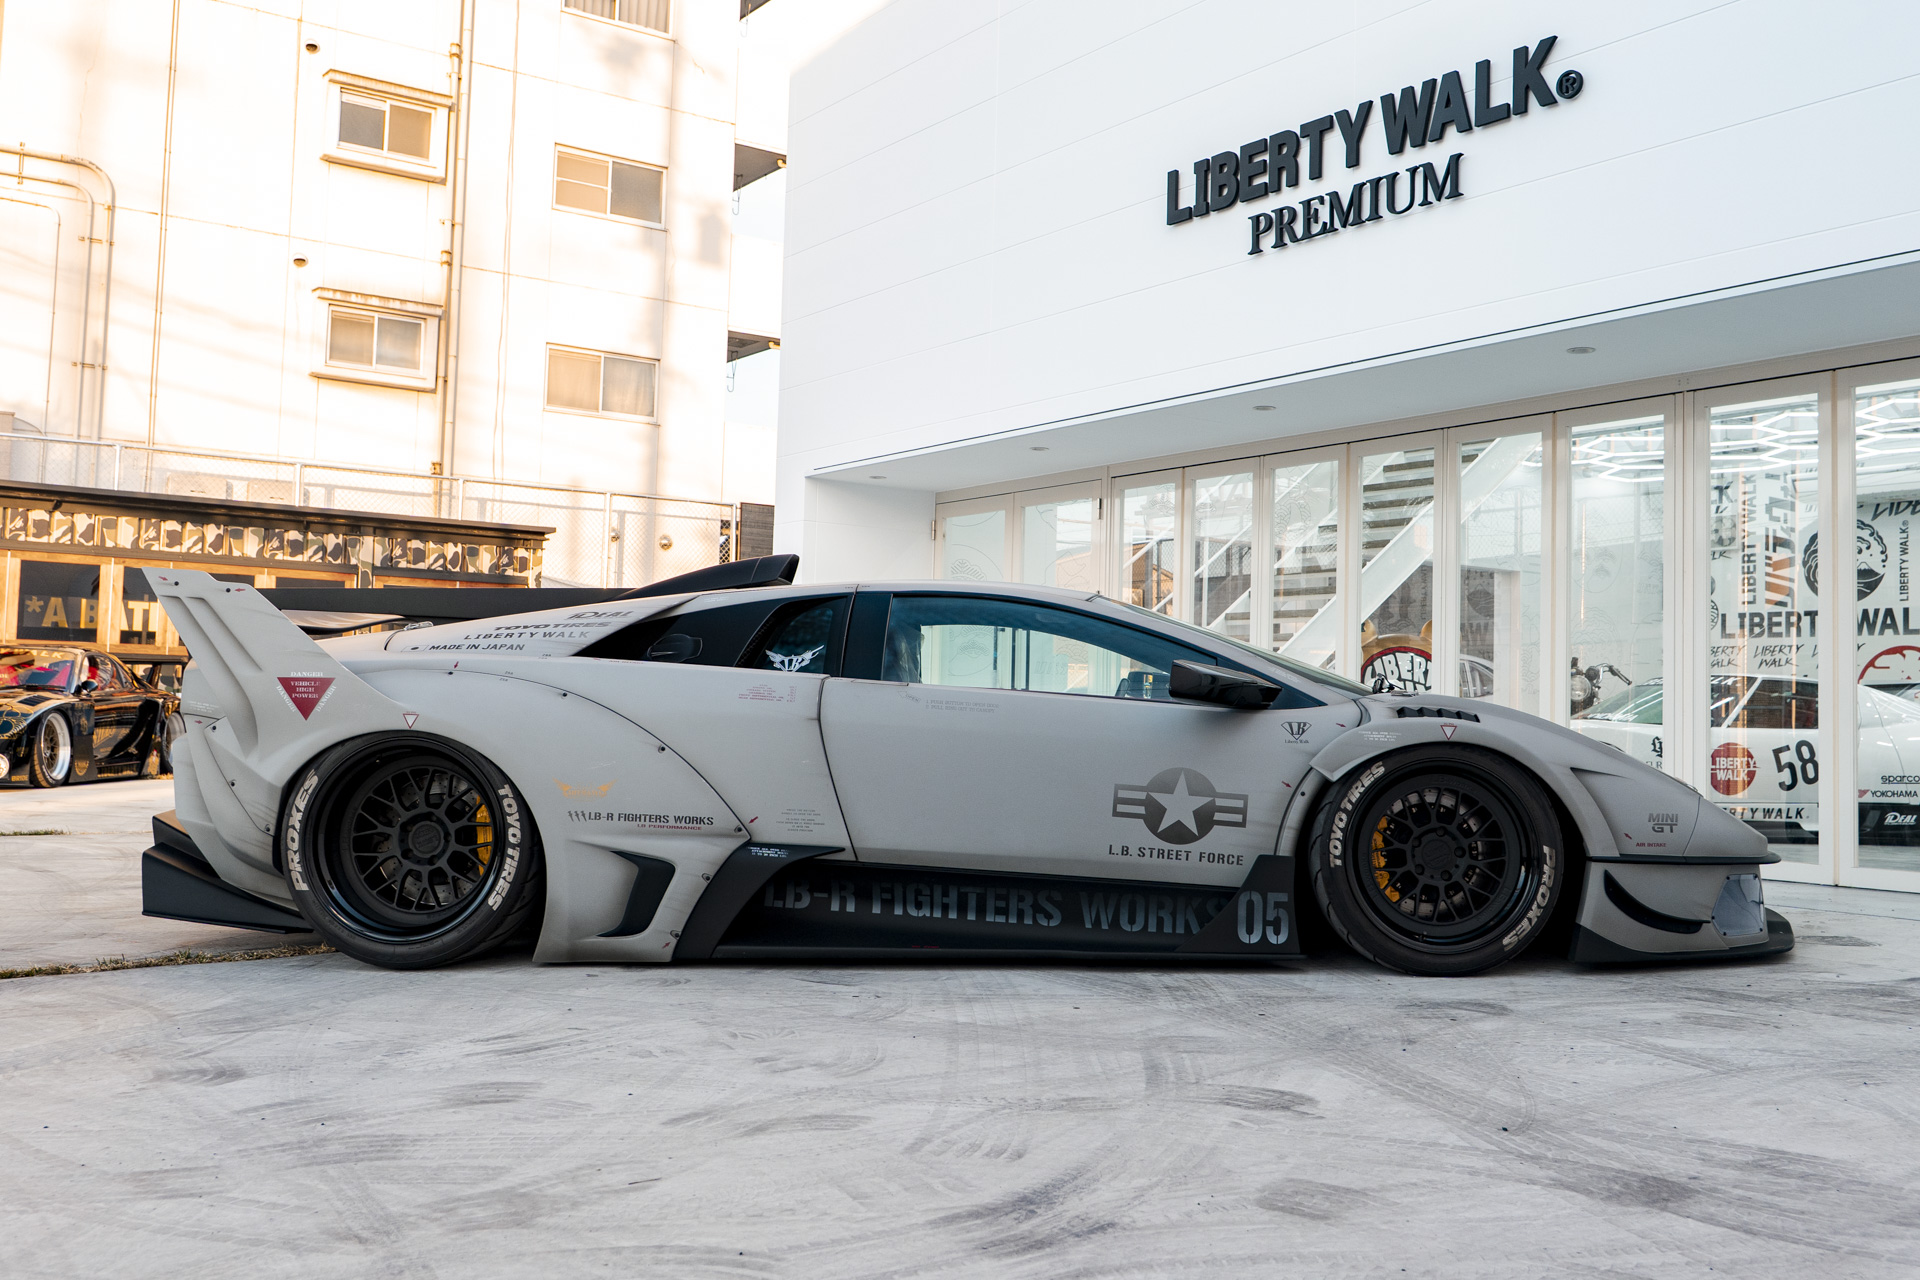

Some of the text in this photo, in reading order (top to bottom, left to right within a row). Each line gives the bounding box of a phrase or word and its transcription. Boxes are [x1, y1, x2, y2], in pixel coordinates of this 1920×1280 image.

[1167, 100, 1374, 225] LIBERTY
[1247, 152, 1464, 255] PREMIUM
[1742, 529, 1757, 605] LIBERTY
[1899, 558, 1909, 602] LIBERTY
[464, 631, 591, 640] LIBERTY WALK
[1721, 607, 1920, 639] LIBERT WAL
[1711, 644, 1746, 658] BERTY
[1753, 643, 1805, 658] LIBERTY
[1757, 657, 1799, 670] WALK
[276, 685, 297, 712] DANGER
[316, 685, 337, 712] DANGER
[1772, 739, 1819, 791] 58
[1870, 790, 1918, 798] YOKOHAMA
[287, 769, 319, 891] PROXES
[588, 811, 714, 826] LB-R FIGHTERS WORKS
[1329, 811, 1348, 868] TOYO
[1340, 761, 1386, 812] TIRES
[1648, 812, 1679, 823] MINI
[1651, 823, 1678, 833] GT
[487, 783, 522, 911] TOYO TIRES
[1108, 844, 1244, 866] L.B. STREET FORCE
[872, 881, 1063, 927] FIGHTERS
[1502, 844, 1556, 951] PROXES
[1236, 890, 1290, 945] 05
